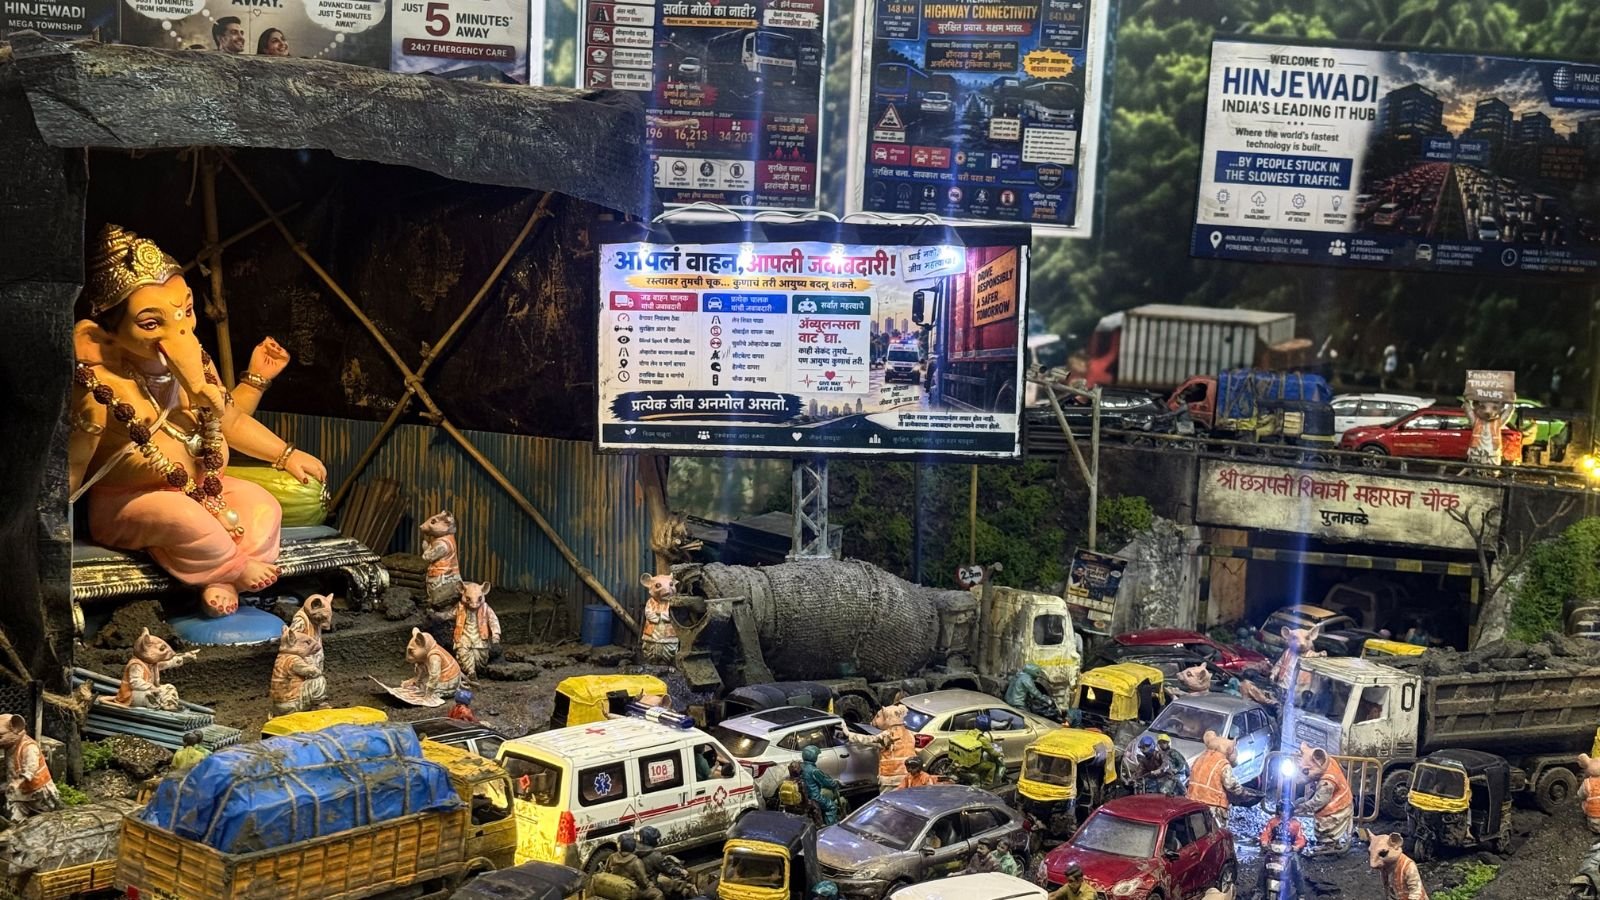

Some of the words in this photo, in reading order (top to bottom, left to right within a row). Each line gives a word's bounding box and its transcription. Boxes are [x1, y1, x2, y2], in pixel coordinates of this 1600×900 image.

[5, 2, 86, 19] HINJEWADI
[136, 4, 155, 12] FROM
[318, 1, 353, 9] ADVANCED
[354, 3, 372, 11] CARE
[663, 2, 687, 15] सर्वात
[714, 5, 727, 16] का
[729, 3, 756, 17] नाही?
[887, 4, 901, 13] 148
[902, 4, 914, 14] KM
[924, 4, 970, 19] HIGHWAY
[972, 5, 1038, 20] CONNECTIVITY
[335, 10, 342, 19] 5
[342, 12, 372, 20] MINUTES
[401, 2, 424, 13] JUST
[425, 2, 451, 37] 5
[8, 19, 34, 28] MEGA
[36, 21, 82, 31] TOWNSHIP
[456, 26, 490, 38] AWAY
[937, 21, 962, 34] सुरक्षित
[411, 43, 431, 52] 24x7
[433, 45, 484, 56] EMERGENCY
[486, 48, 508, 57] CARE
[1270, 54, 1319, 67] WELCOME
[1322, 58, 1335, 68] TO
[1222, 66, 1379, 103] HINJEWADI
[1222, 99, 1270, 114] INDIA'S
[1273, 102, 1331, 118] LEADING
[1334, 106, 1347, 119] IT
[1349, 107, 1376, 121] HUB
[674, 128, 708, 141] 16,213
[1235, 127, 1263, 137] Where
[1264, 128, 1278, 138] the
[1280, 130, 1309, 140] world's
[1311, 132, 1339, 142] fastest
[1246, 139, 1291, 152] technology
[1293, 142, 1300, 150] is
[1302, 143, 1328, 152] built...
[1229, 156, 1252, 168] ...BY
[1256, 157, 1293, 170] PEOPLE
[1295, 160, 1328, 172] STUCK
[1329, 161, 1340, 173] IN
[1225, 169, 1245, 181] THE
[1248, 171, 1296, 184] SLOWEST
[1298, 174, 1342, 187] TRAFFIC.
[614, 246, 681, 272] आपलं
[685, 252, 744, 276] वाहन,
[747, 247, 804, 274] आपली
[808, 249, 897, 277] जबाबदारी!
[977, 266, 993, 282] DRIVE
[977, 268, 1014, 293] RESPONSIBLY
[680, 276, 703, 289] तुमची
[732, 277, 760, 290] कुणाचं
[762, 277, 776, 288] तरी
[778, 279, 807, 291] आयुष्य
[809, 280, 830, 291] बदलू
[831, 279, 857, 290] शकते.
[976, 298, 981, 309] A
[981, 291, 999, 307] SAFER
[976, 299, 1010, 321] TOMORROW
[798, 332, 819, 344] वाट
[823, 332, 842, 344] द्या.
[798, 346, 813, 356] काही
[814, 346, 831, 356] सेकंद
[809, 357, 830, 367] आयुष्य
[631, 396, 667, 412] प्रत्येक
[669, 395, 694, 410] जीव
[697, 396, 744, 411] अनमोल
[747, 396, 790, 412] असतो.
[1217, 468, 1238, 491] श्री
[1239, 472, 1295, 498] छत्रपती
[1297, 474, 1349, 502] शिवाजी
[1353, 484, 1414, 510] महाराज
[1419, 487, 1460, 512] चौक
[1319, 507, 1369, 527] पुनावळे
[960, 569, 982, 580] 2.5m
[650, 764, 668, 777] 108
